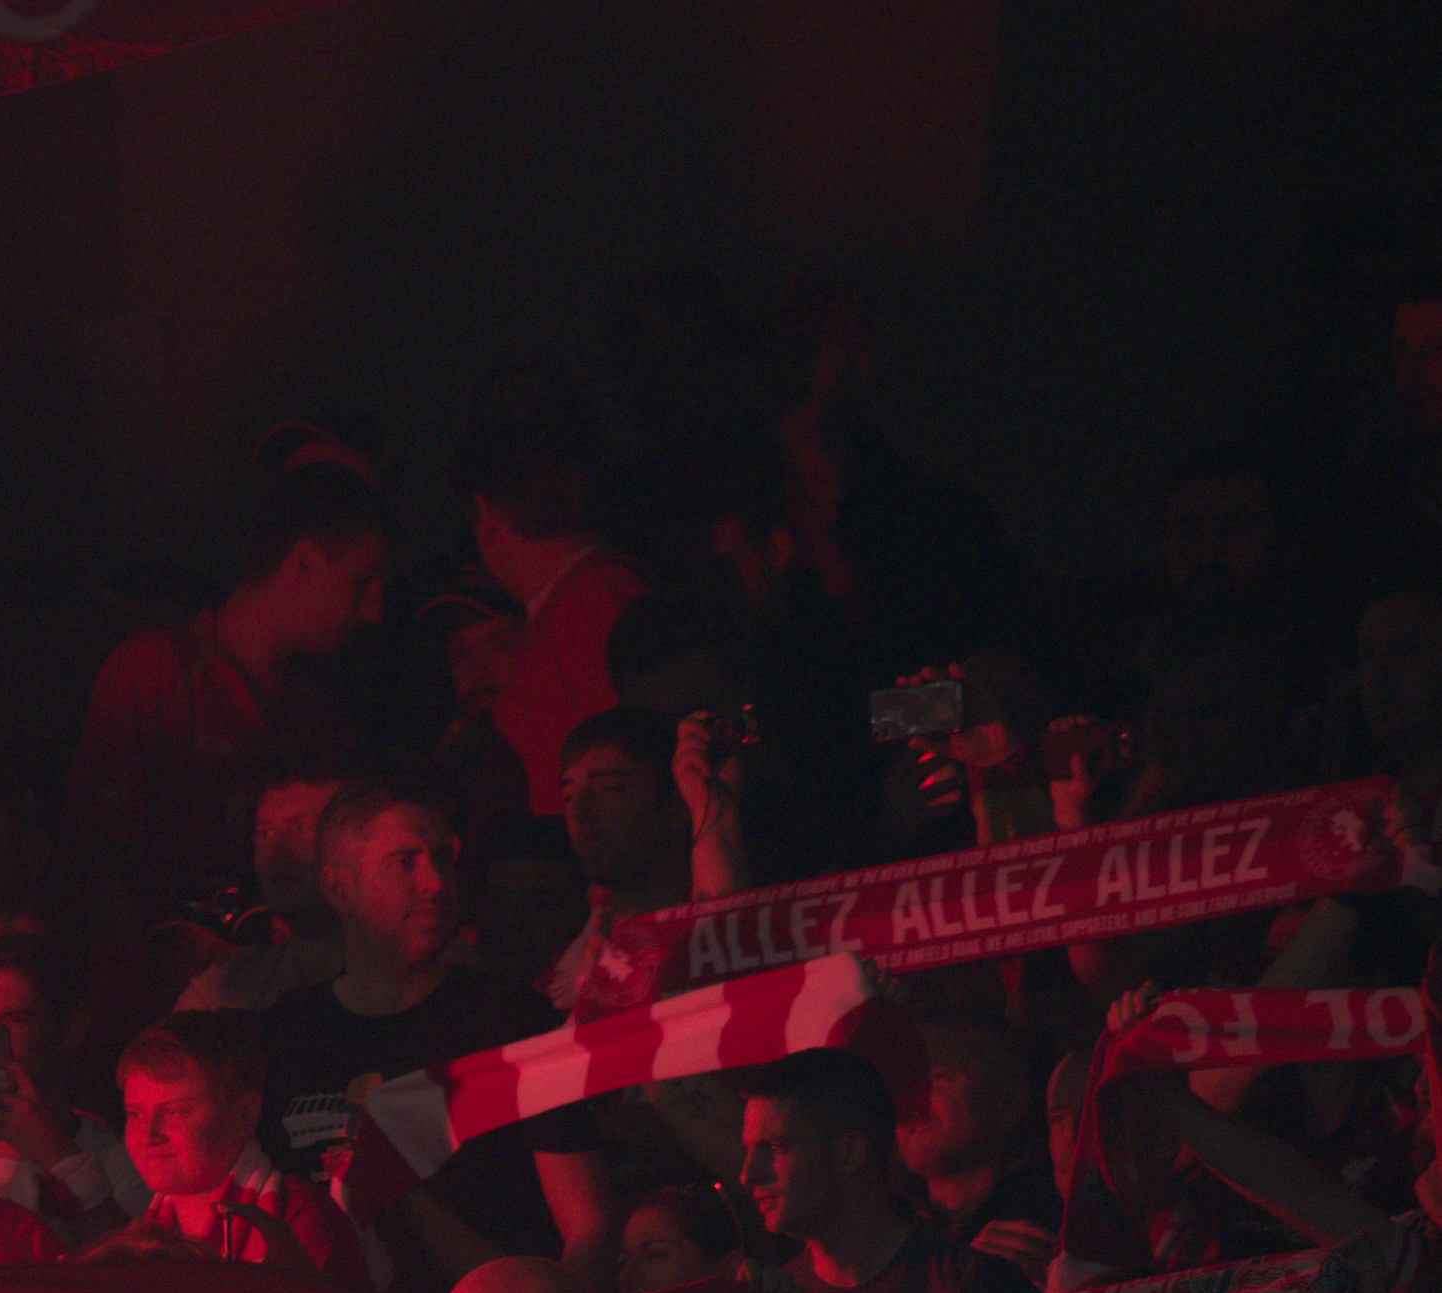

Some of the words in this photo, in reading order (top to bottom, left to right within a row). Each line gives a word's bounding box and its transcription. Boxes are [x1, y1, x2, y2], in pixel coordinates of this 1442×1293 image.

[688, 891, 864, 979] ALLEZ
[890, 856, 1066, 945] ALLEZ
[1095, 815, 1271, 909] ALLEZ
